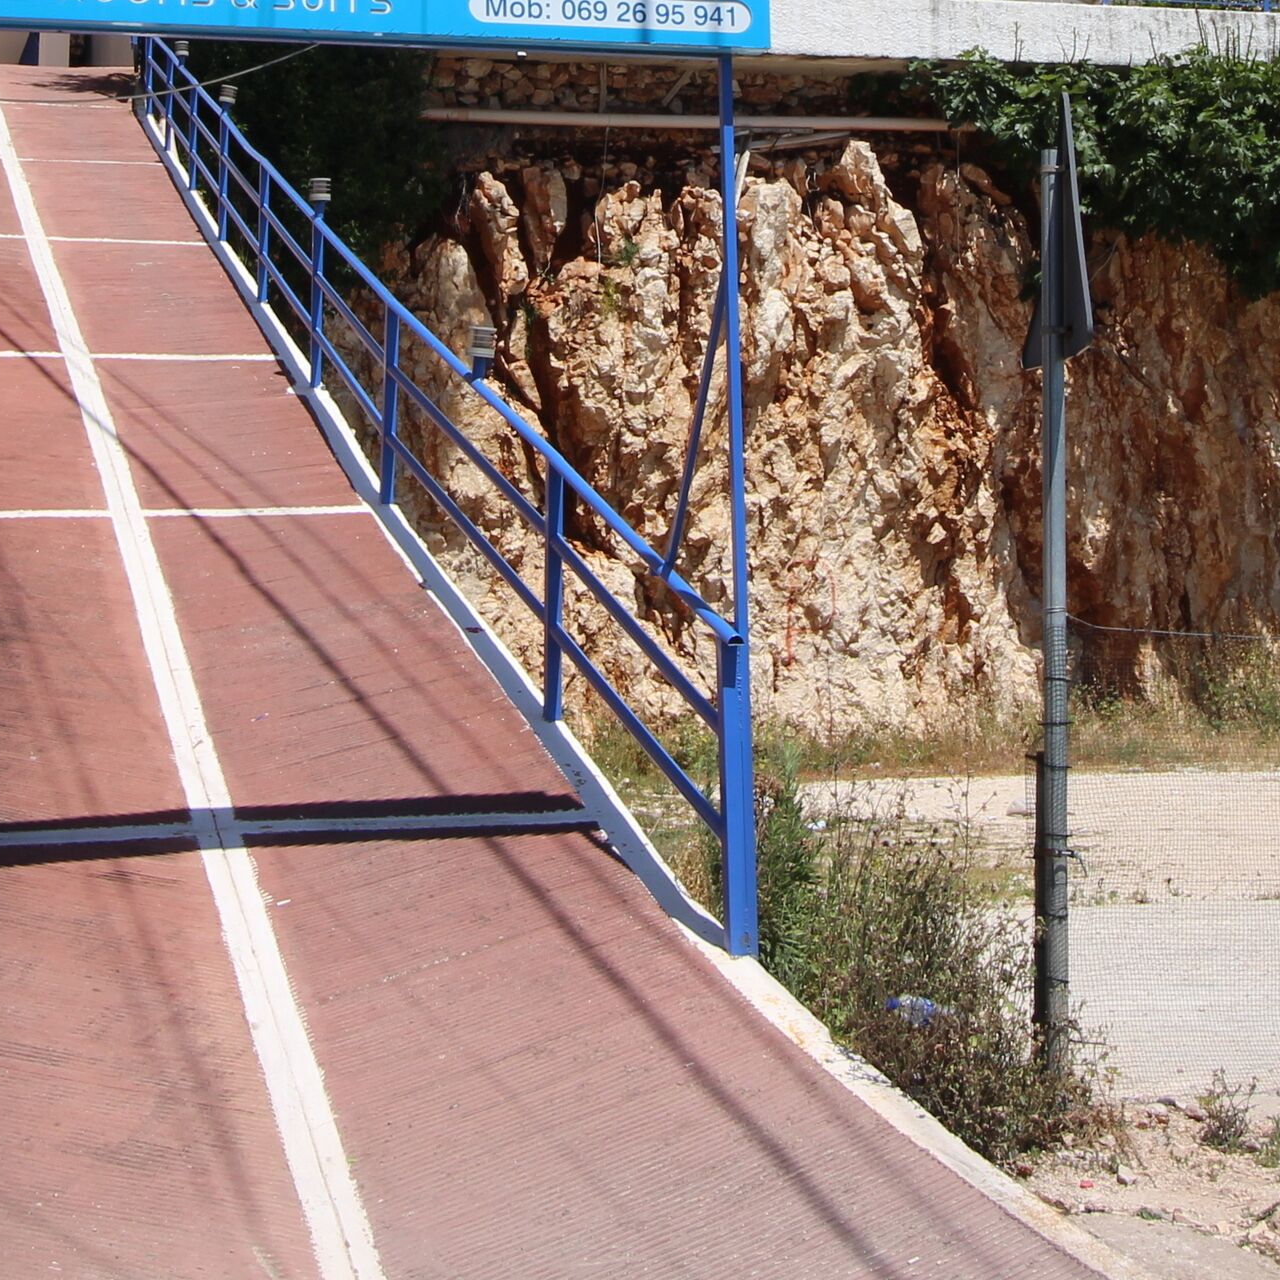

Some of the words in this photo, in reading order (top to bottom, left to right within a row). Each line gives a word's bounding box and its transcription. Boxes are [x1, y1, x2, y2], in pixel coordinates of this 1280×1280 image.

[561, 0, 608, 22] 069
[616, 2, 647, 24] 26
[655, 4, 685, 26] 95
[694, 5, 736, 27] 941
